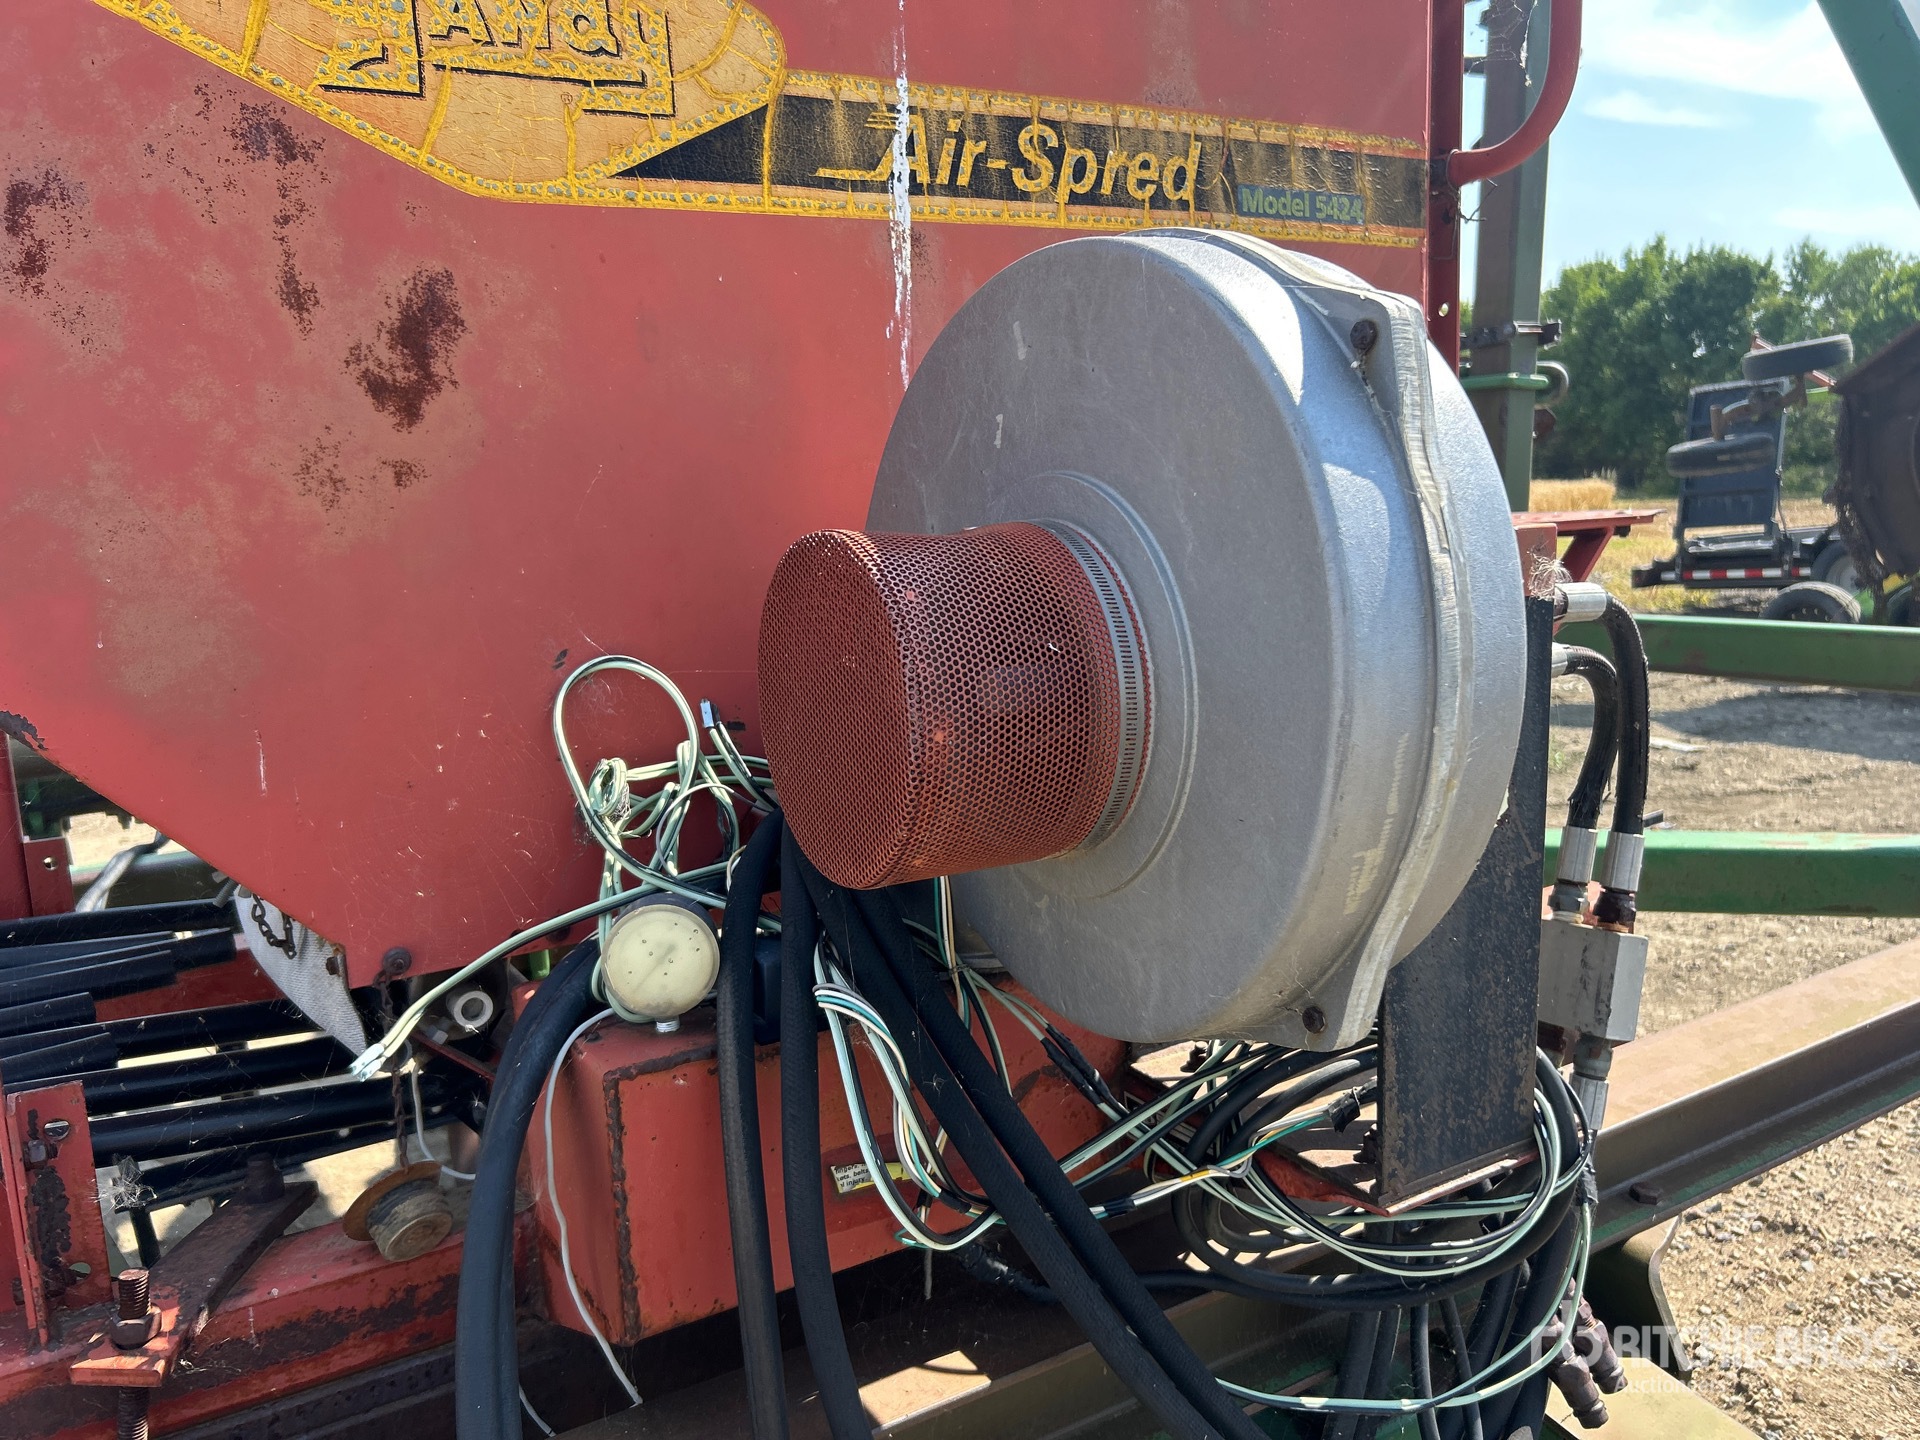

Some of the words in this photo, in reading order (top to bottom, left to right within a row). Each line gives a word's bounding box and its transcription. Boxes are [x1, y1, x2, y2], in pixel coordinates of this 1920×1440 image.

[811, 112, 1202, 203] Air-Spred
[1241, 188, 1311, 218] Model
[1315, 194, 1363, 224] 5424
